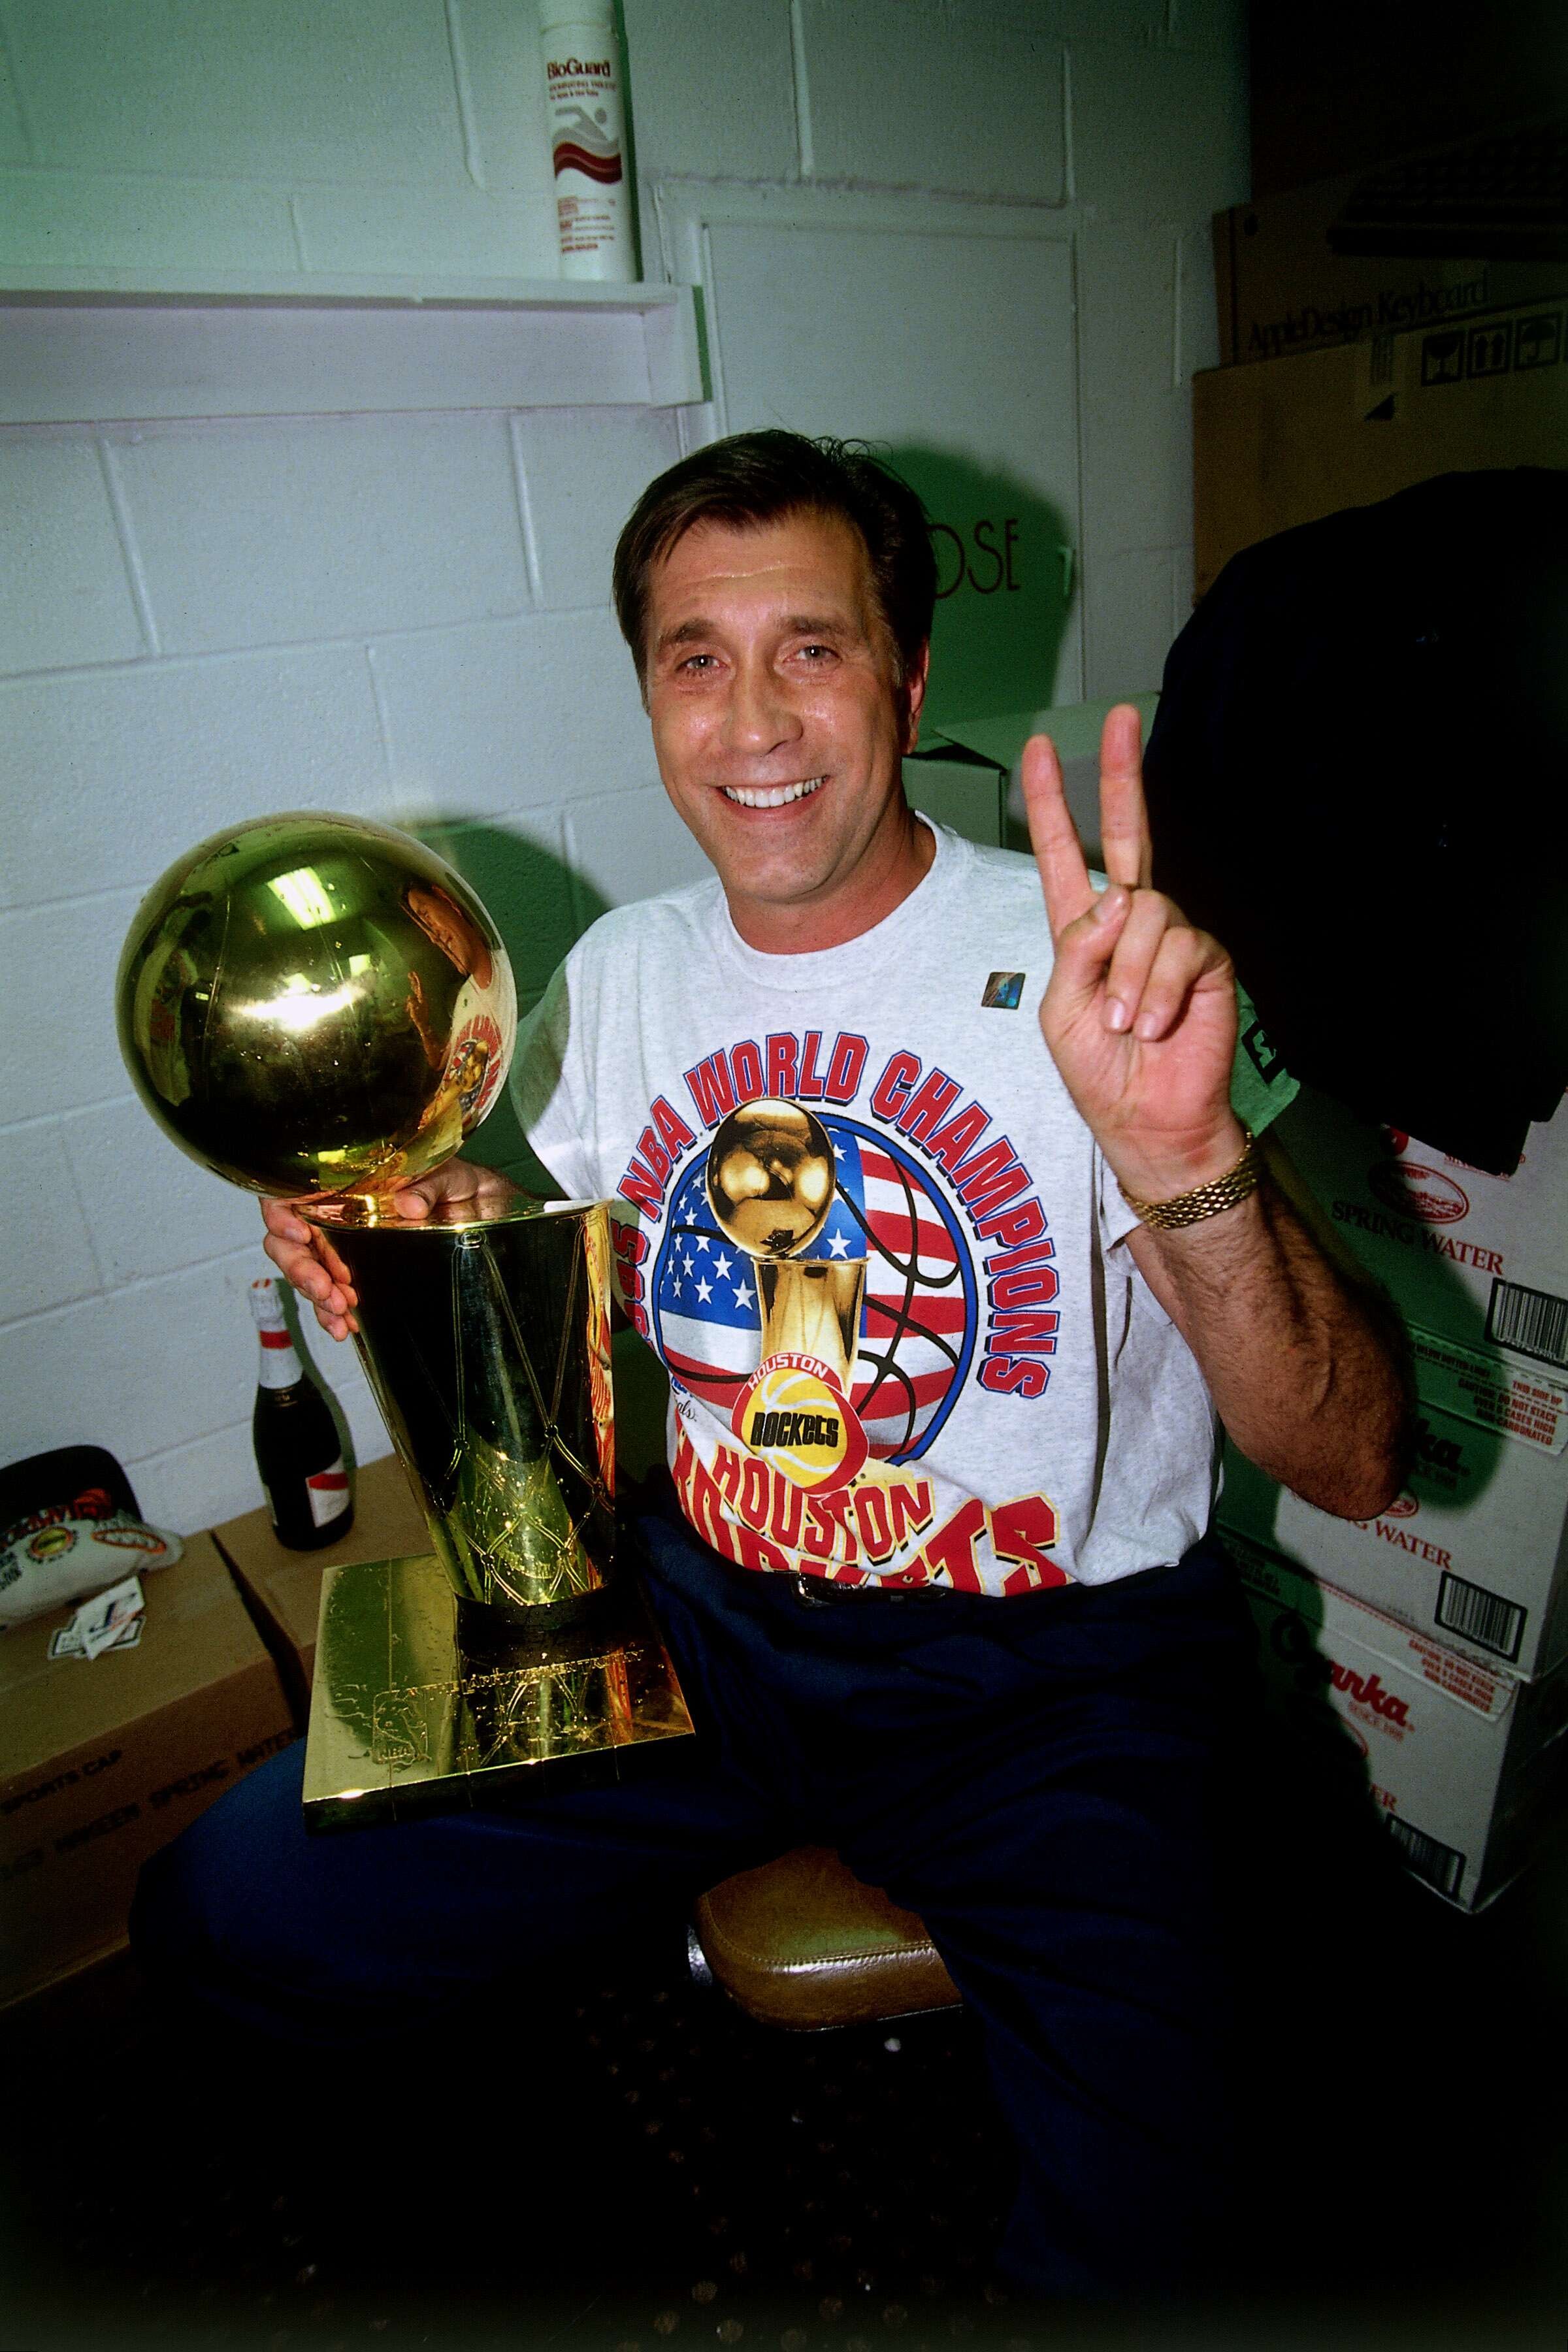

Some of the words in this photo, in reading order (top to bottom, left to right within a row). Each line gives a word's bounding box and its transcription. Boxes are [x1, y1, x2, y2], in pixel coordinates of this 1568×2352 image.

[547, 57, 611, 79] BioGuard
[617, 1094, 698, 1224] NBA
[684, 1030, 872, 1128] WORLD
[869, 1049, 1062, 1400] CHAMPIONS
[1332, 1201, 1416, 1244] SPRING
[1421, 1230, 1503, 1275] WATER
[747, 1353, 829, 1392] HOUSTON
[710, 1442, 935, 1566] HOUSTON
[1375, 1517, 1453, 1571] WATER
[82, 1749, 122, 1776] CAP
[235, 1727, 295, 1767] WATE
